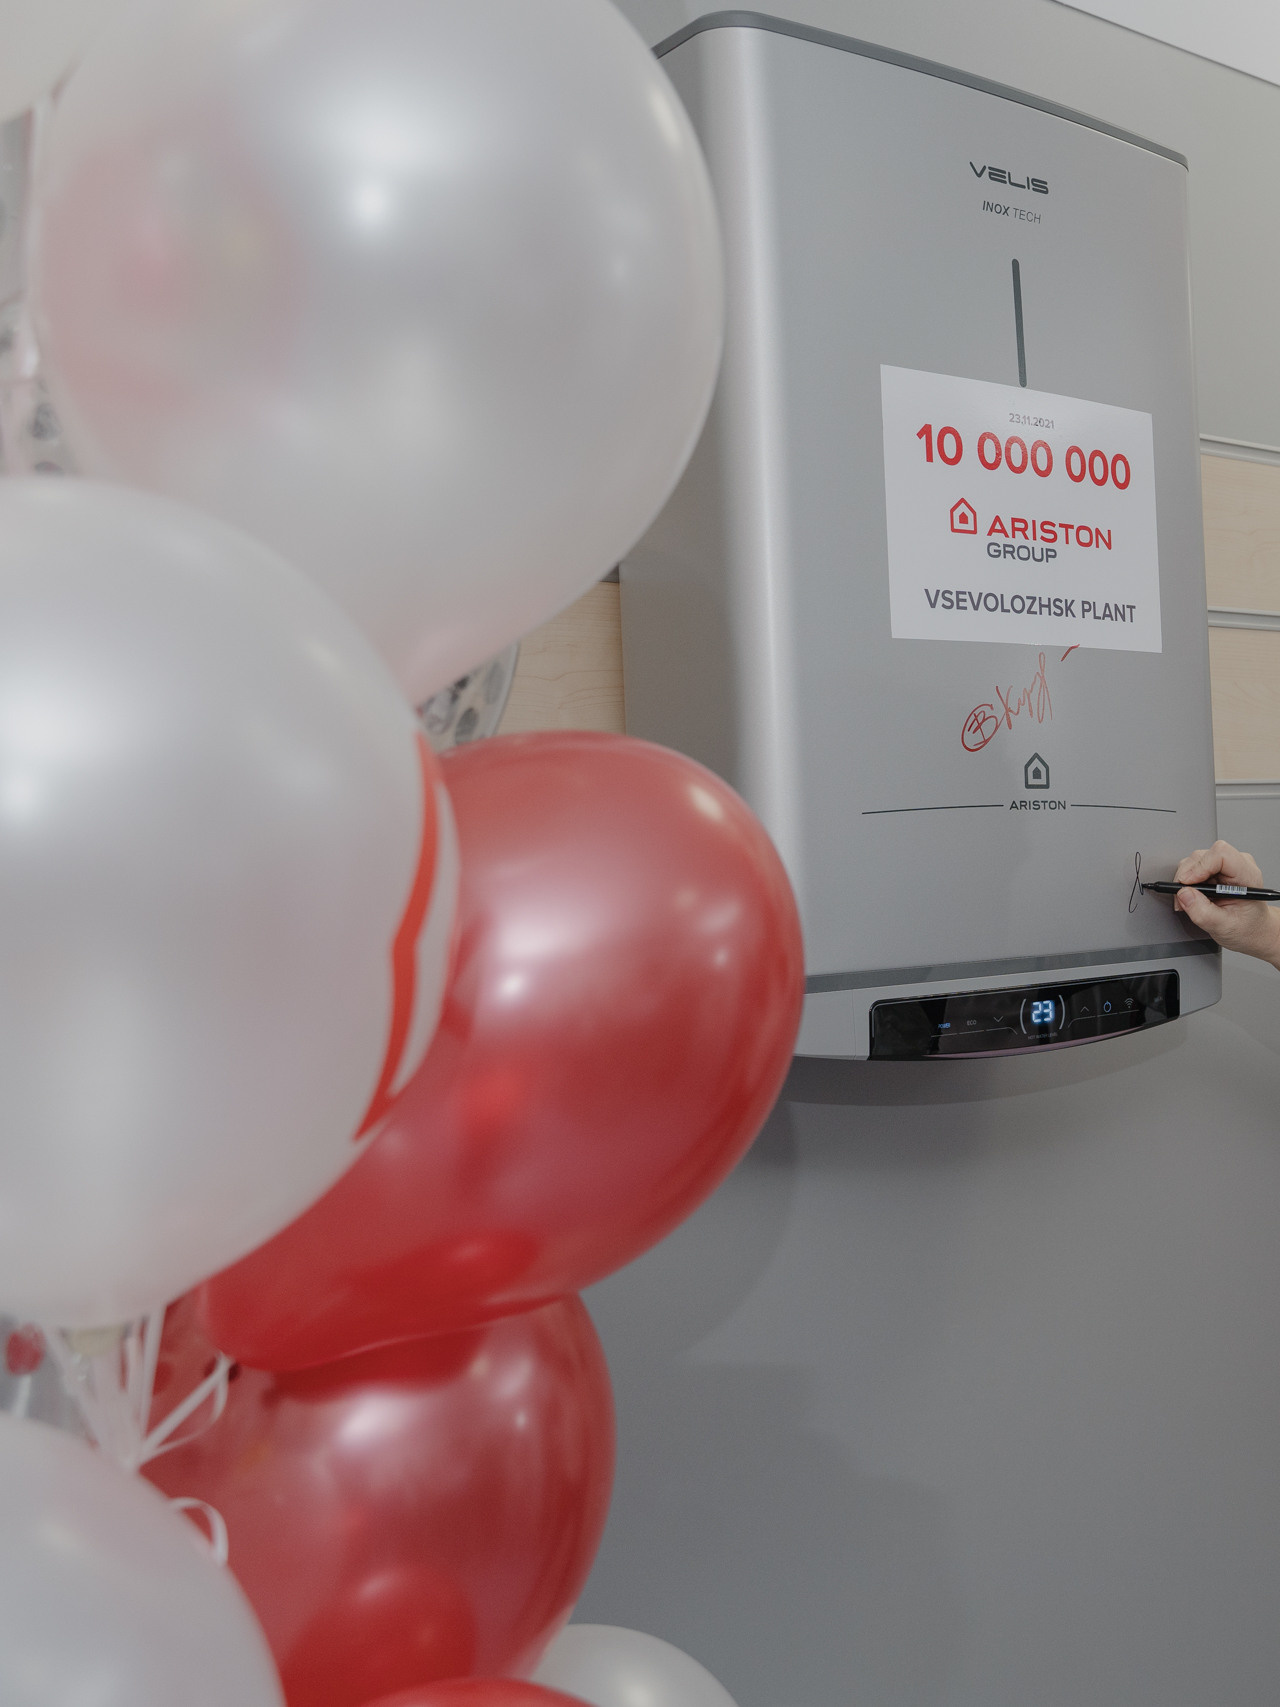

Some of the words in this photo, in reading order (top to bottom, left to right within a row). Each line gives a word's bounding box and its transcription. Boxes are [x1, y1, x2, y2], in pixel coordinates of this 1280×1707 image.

[969, 161, 1049, 194] VELIS
[982, 200, 1010, 217] INOX
[1012, 207, 1041, 224] TECH
[1008, 412, 1055, 430] 23.11.2021
[916, 423, 963, 466] 10
[976, 431, 1053, 478] 000
[1065, 445, 1131, 490] 000
[986, 515, 1112, 551] ARISTON
[986, 542, 1057, 563] GROUP
[924, 588, 1076, 618] VSEVOLOZHSK
[1081, 600, 1136, 623] PLANT
[1009, 800, 1066, 811] ARISTON
[1032, 1000, 1053, 1023] 23
